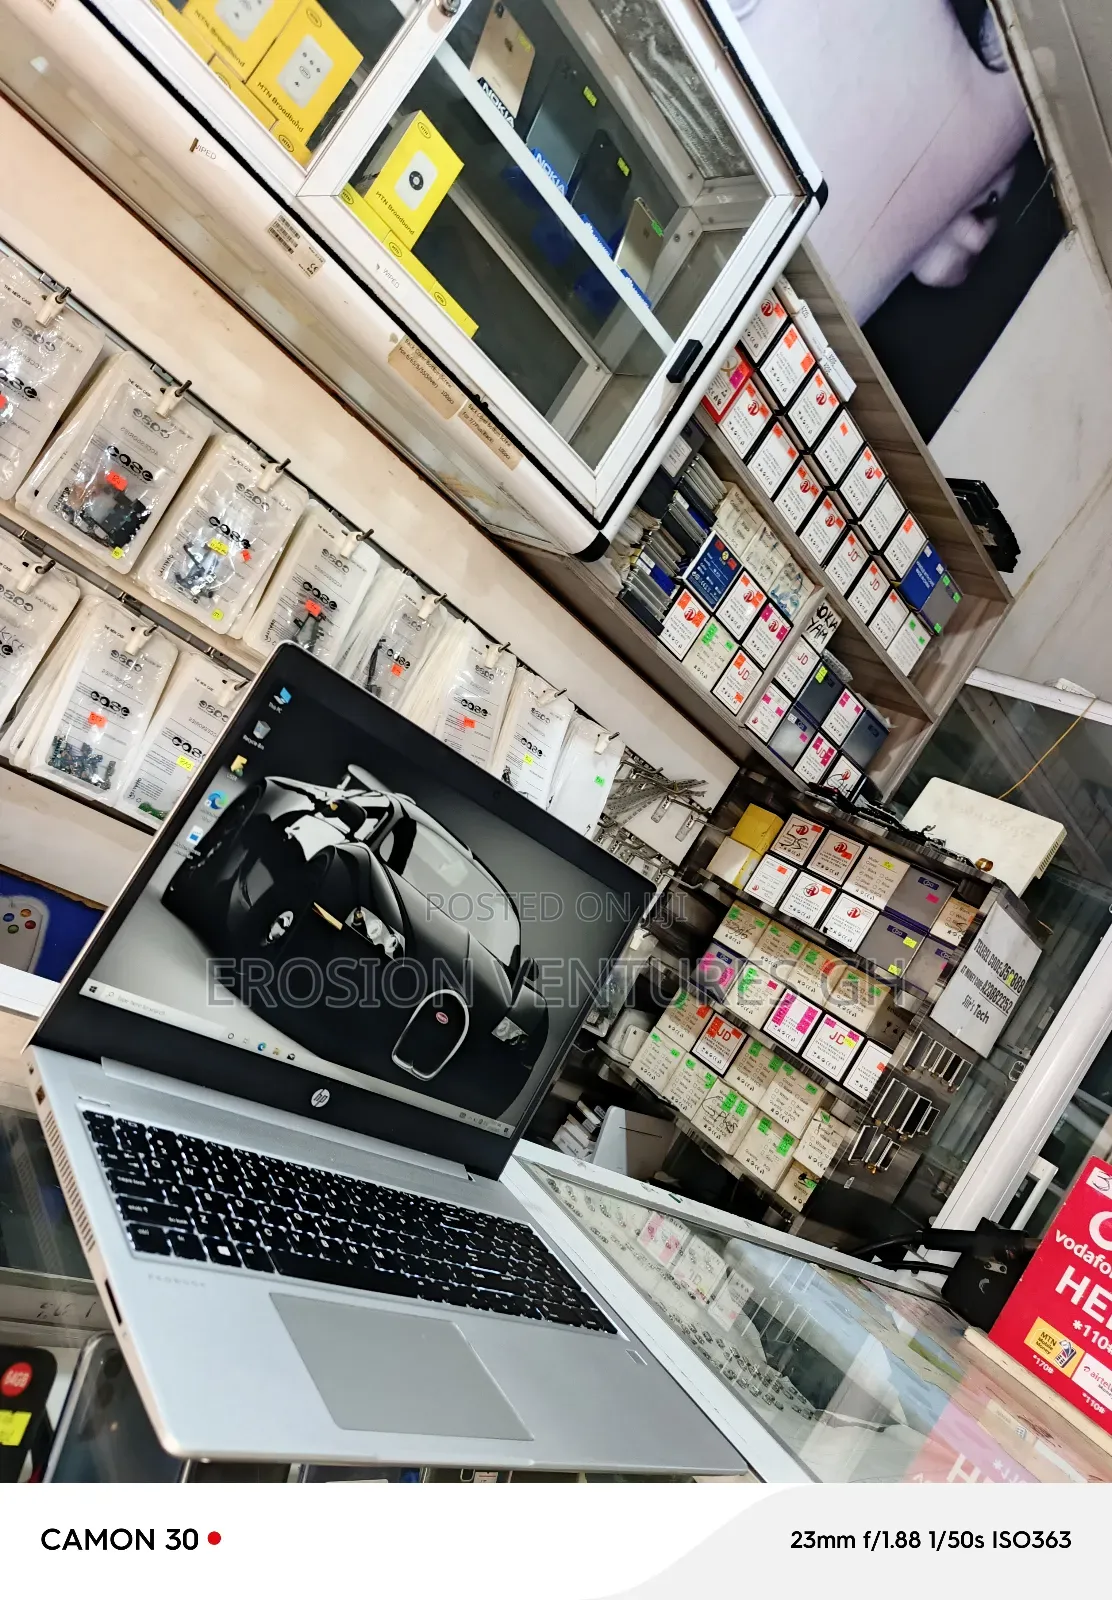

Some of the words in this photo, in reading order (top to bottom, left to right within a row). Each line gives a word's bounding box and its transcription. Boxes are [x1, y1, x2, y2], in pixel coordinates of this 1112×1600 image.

[257, 81, 272, 99] MTN
[271, 97, 304, 133] Broadband
[482, 82, 516, 129] NOKIA
[535, 152, 567, 194] NOKIA
[375, 191, 388, 206] MTN
[388, 204, 415, 236] Broadband
[4, 284, 12, 292] THE
[12, 290, 22, 299] NEW
[106, 445, 154, 482] case
[208, 515, 252, 550] case
[302, 581, 338, 611] case
[797, 652, 809, 666] JD
[737, 667, 750, 681] JD
[90, 690, 131, 717] case
[459, 698, 490, 718] case
[171, 736, 207, 761] cas
[519, 736, 543, 758] case
[972, 1002, 990, 1025] Tech
[716, 1028, 732, 1042] JD
[151, 1159, 161, 1169] Q
[184, 1167, 194, 1176] W
[216, 1174, 224, 1183] E
[171, 1185, 180, 1194] A
[200, 1214, 208, 1224] Z
[233, 1221, 243, 1231] X
[264, 1227, 273, 1237] C
[1055, 1265, 1112, 1334] HE
[1037, 1336, 1054, 1351] Mobile
[1040, 1331, 1058, 1347] MTN
[1035, 1341, 1051, 1355] Money
